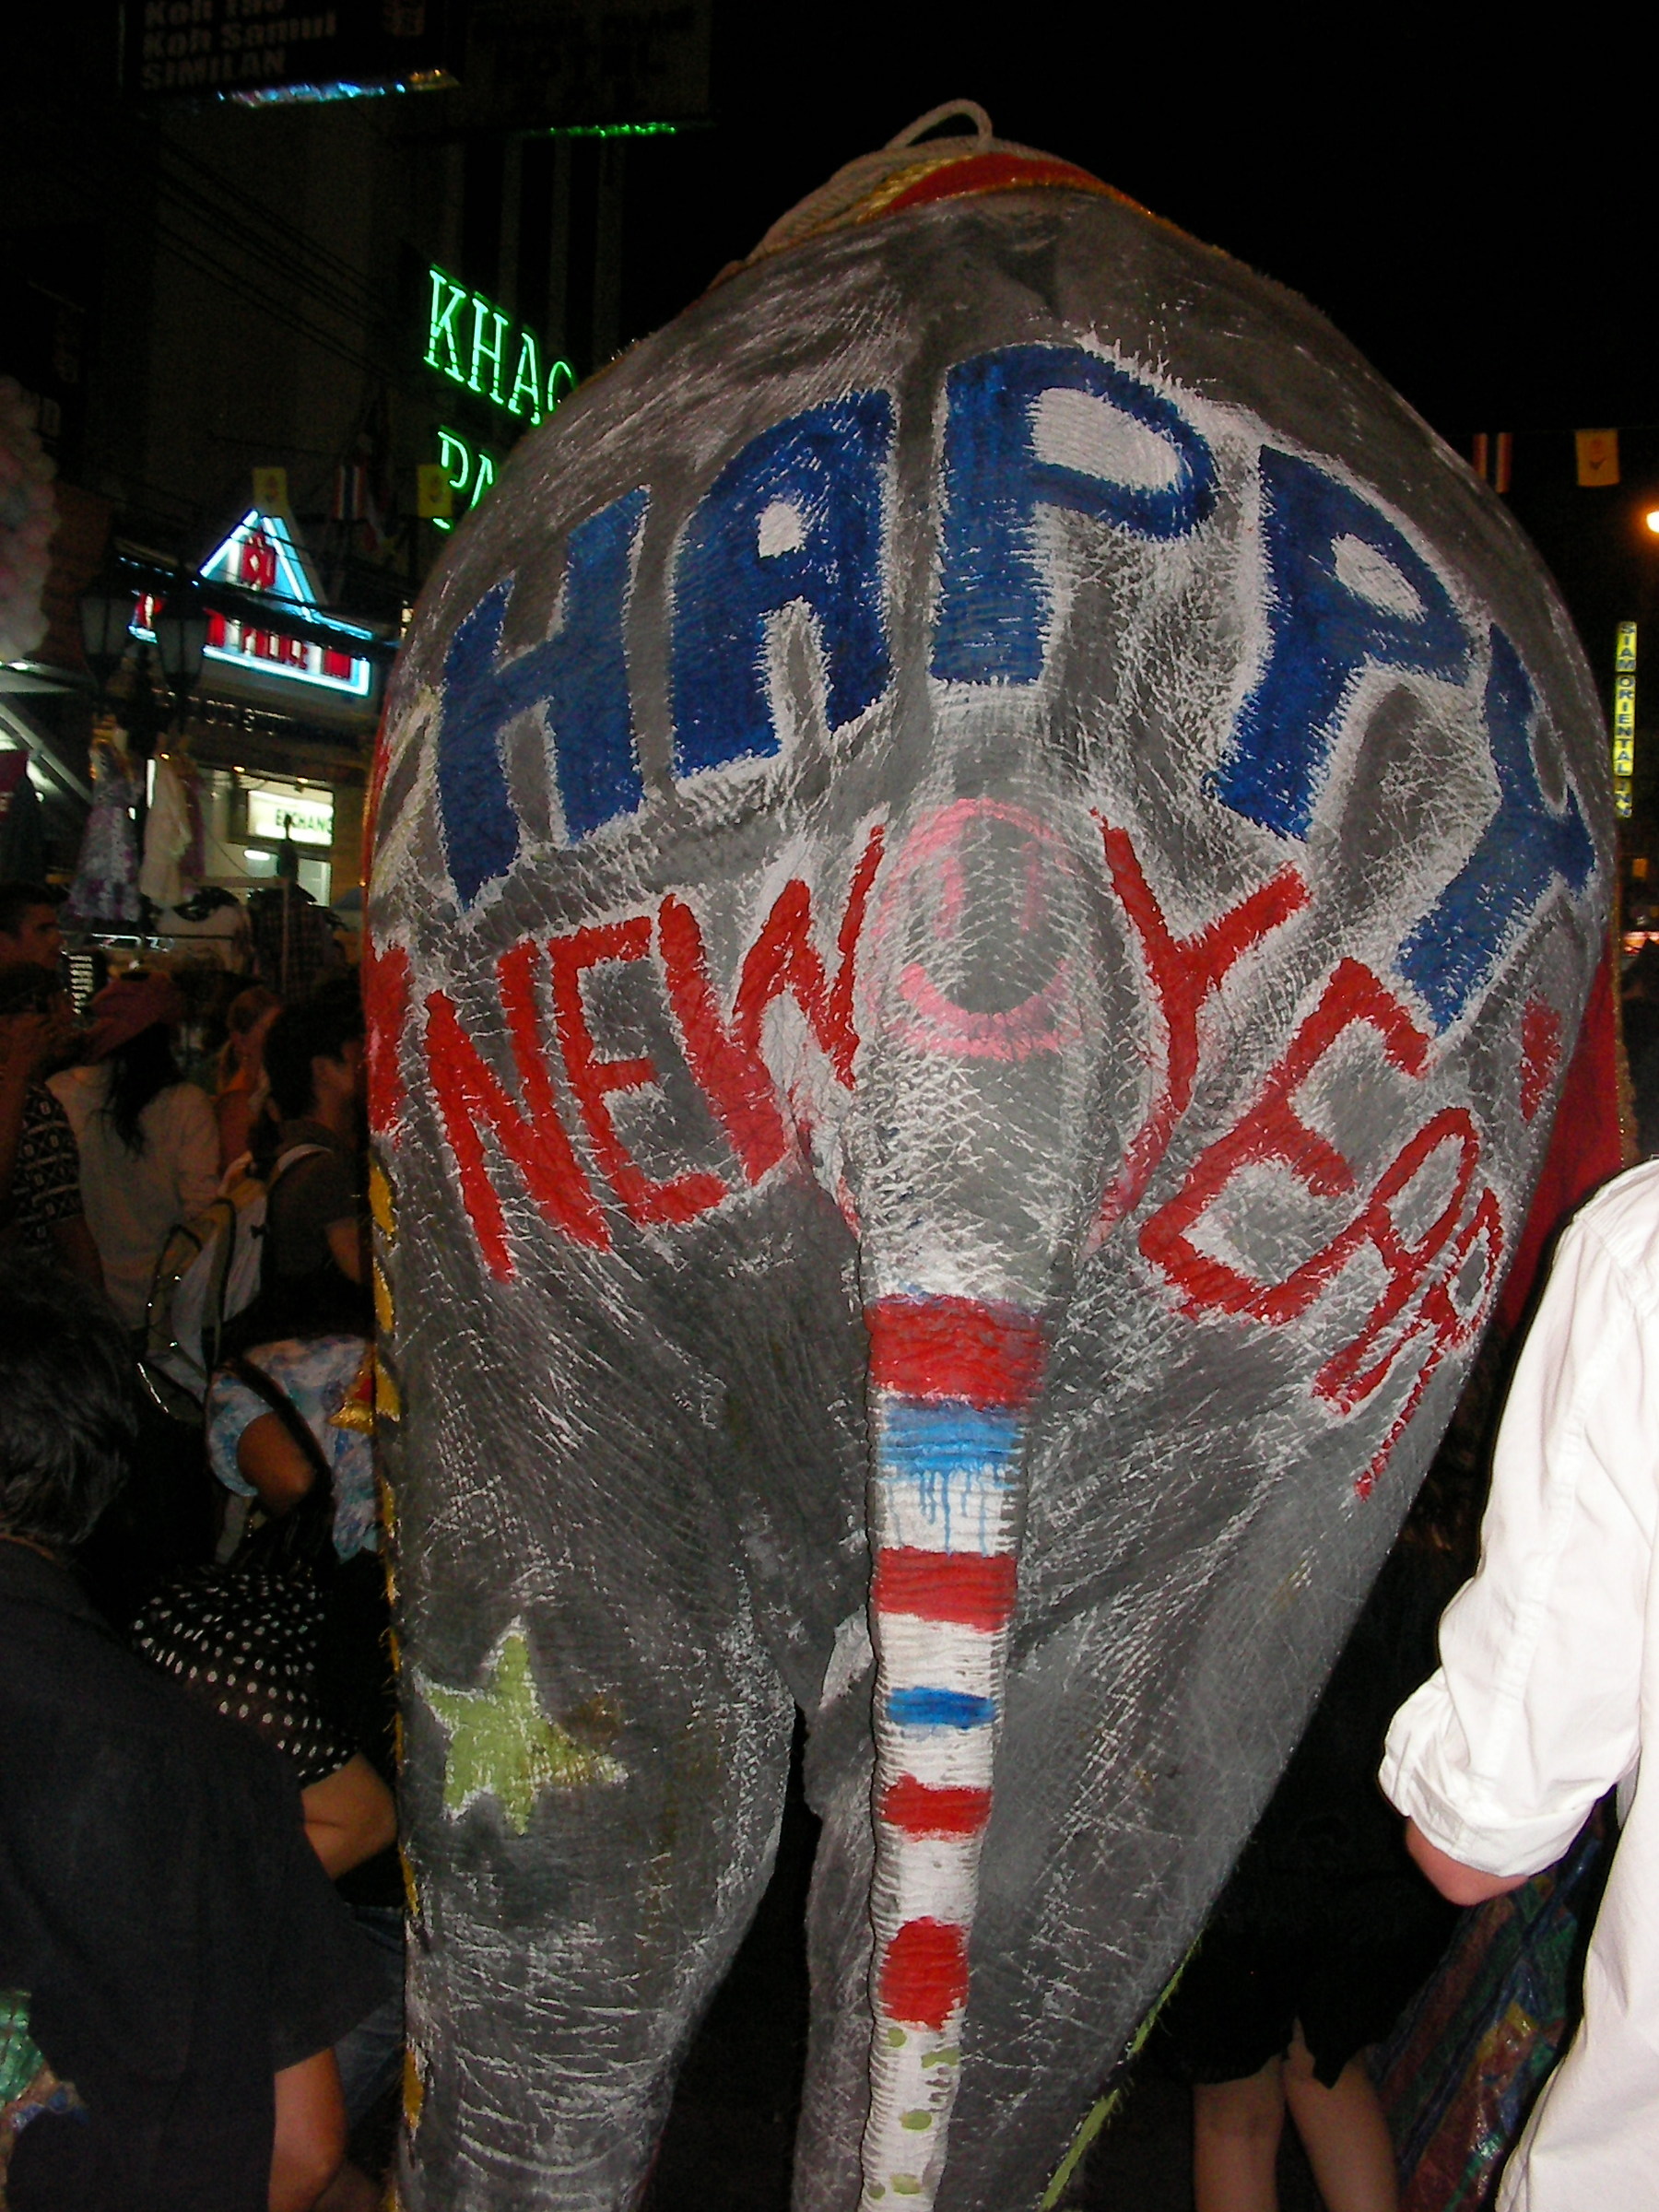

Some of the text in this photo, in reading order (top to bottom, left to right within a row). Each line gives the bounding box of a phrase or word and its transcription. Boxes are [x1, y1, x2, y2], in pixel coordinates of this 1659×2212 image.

[142, 47, 287, 90] SIMILAN
[435, 343, 1599, 1035] HAPPY
[1618, 623, 1637, 671] SIAM
[1616, 676, 1635, 774] ORIENTAL
[426, 806, 1506, 1500] NEW YEAR
